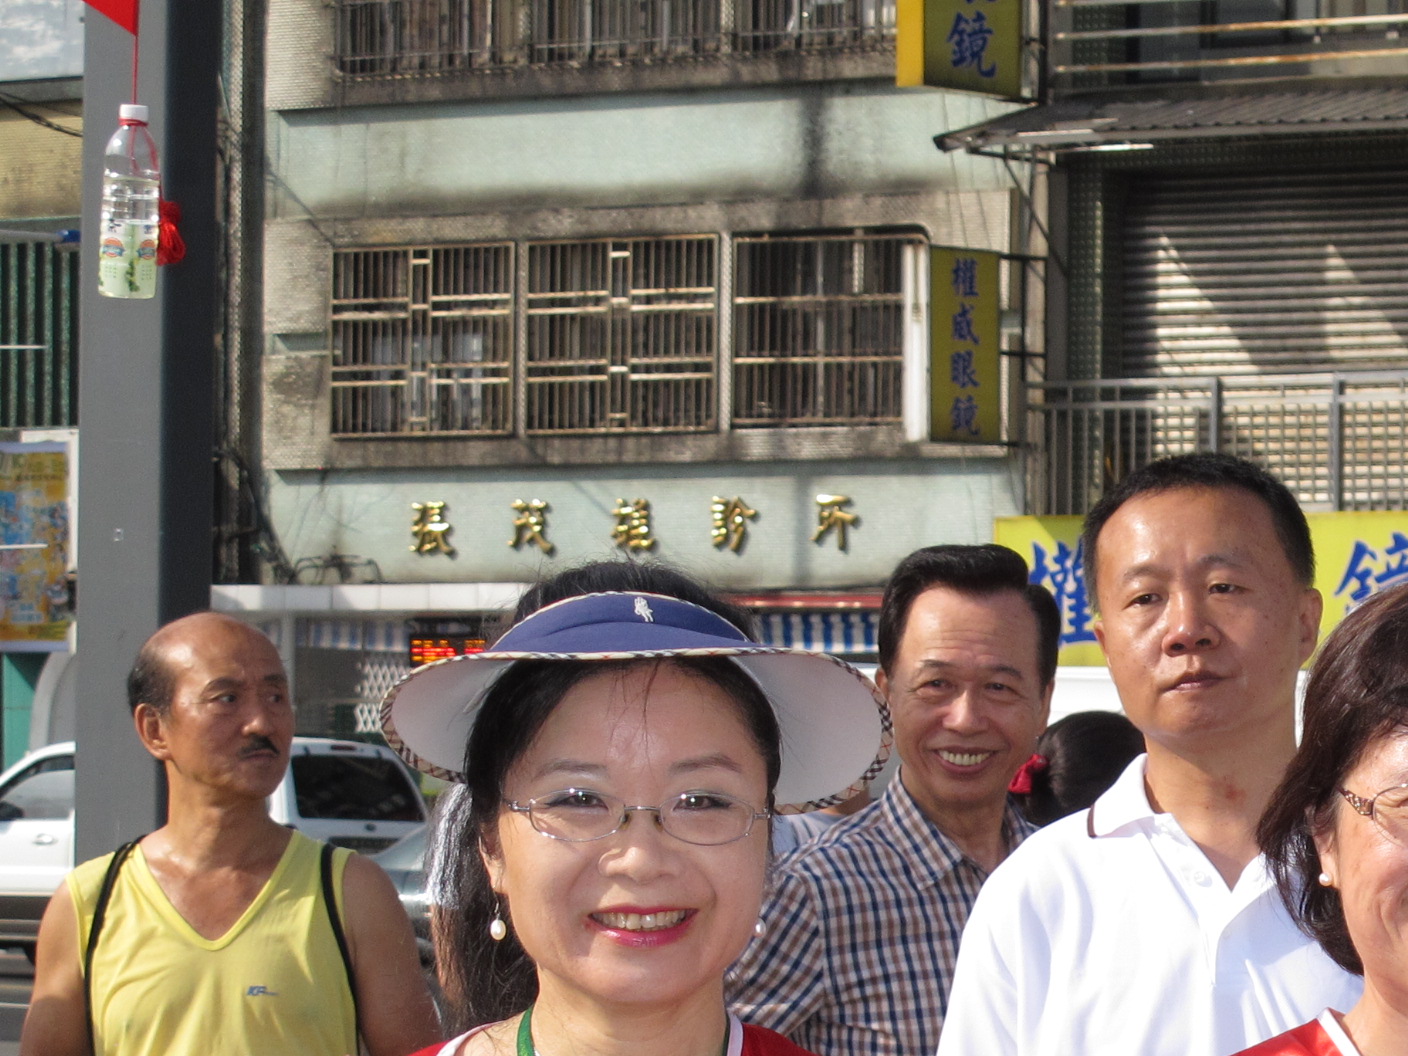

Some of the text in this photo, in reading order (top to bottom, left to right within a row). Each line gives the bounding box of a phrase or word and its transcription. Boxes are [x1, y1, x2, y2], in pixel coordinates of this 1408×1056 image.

[946, 0, 997, 78] 鏡
[951, 257, 981, 436] 權威眼鏡
